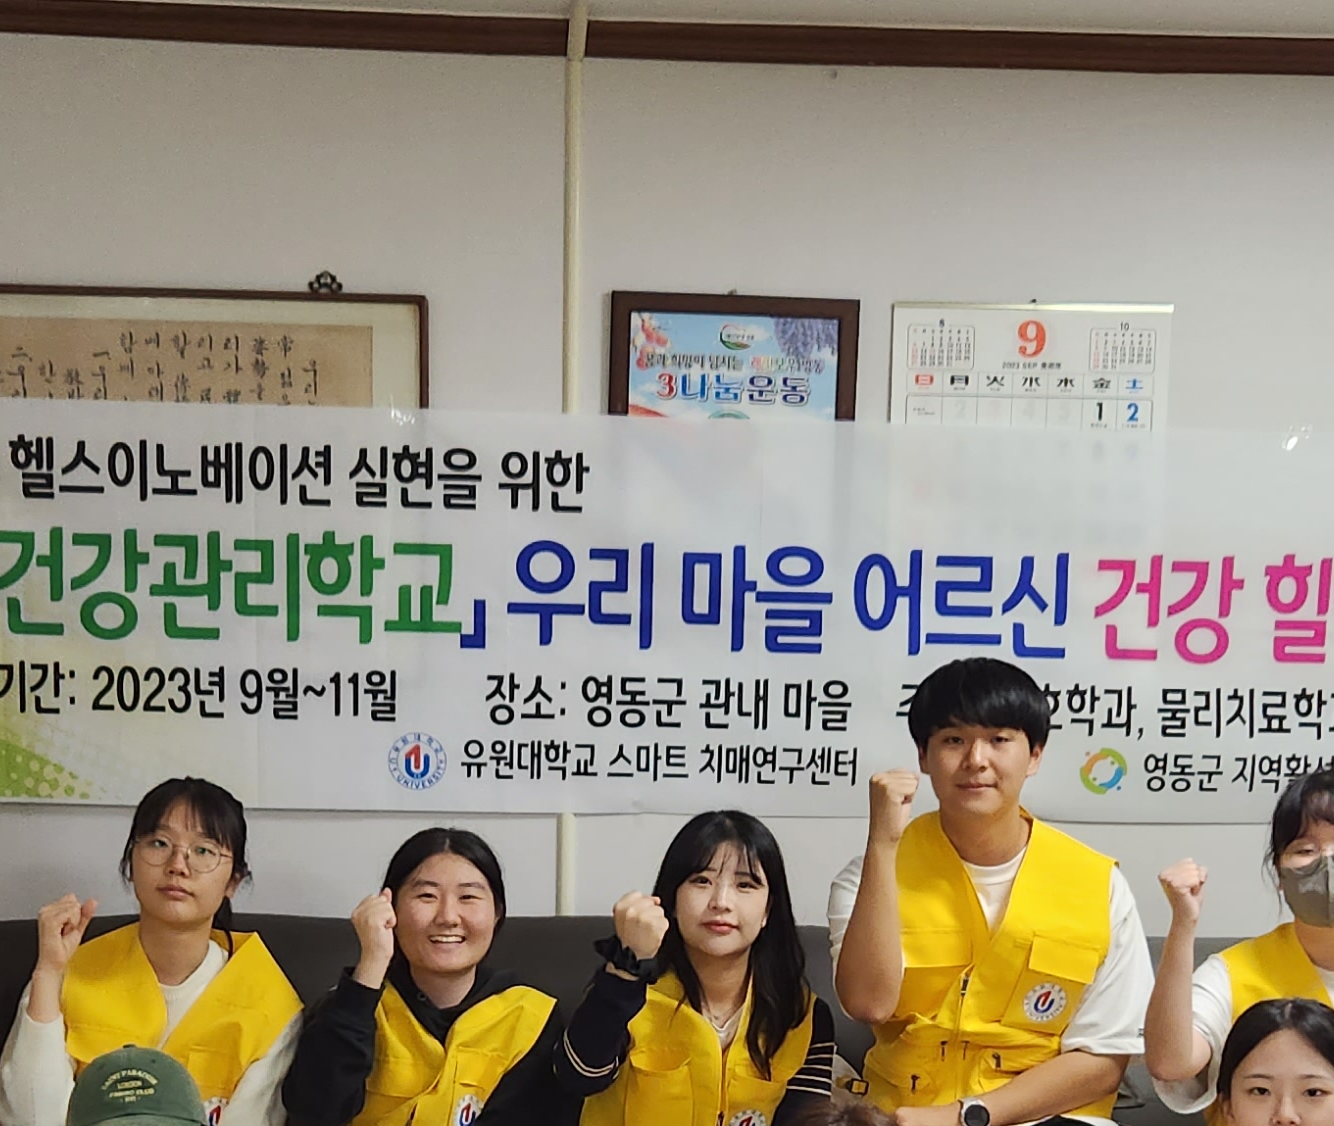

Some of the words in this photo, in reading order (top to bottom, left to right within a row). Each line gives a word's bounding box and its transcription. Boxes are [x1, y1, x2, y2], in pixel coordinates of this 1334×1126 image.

[1120, 321, 1130, 332] 10
[1017, 319, 1046, 359] 9
[915, 374, 934, 386] 日
[950, 375, 969, 386] 月
[986, 375, 1005, 387] 火
[1021, 376, 1041, 388] 水
[1093, 377, 1111, 389] 金
[1125, 378, 1144, 390] 土
[1096, 402, 1104, 421] 1
[1126, 402, 1140, 422] 2
[8, 434, 333, 507] 헬스이노베이션
[348, 444, 482, 511] 실현을
[498, 450, 591, 514] 위한
[507, 540, 655, 651] 우리
[681, 545, 834, 655] 마을
[853, 549, 1070, 660] 어르신
[1093, 554, 1245, 665] 건강
[91, 665, 225, 719] 2023년
[239, 667, 397, 722] 9월~11월
[485, 673, 566, 726] 장소:
[581, 674, 688, 728] 영동군
[699, 677, 770, 731] 관내
[783, 679, 853, 732] 마을
[460, 739, 598, 781] 유원대학교
[607, 742, 689, 782] 스마트
[699, 744, 859, 787] 치매연구센터
[1143, 752, 1223, 793] 영동군
